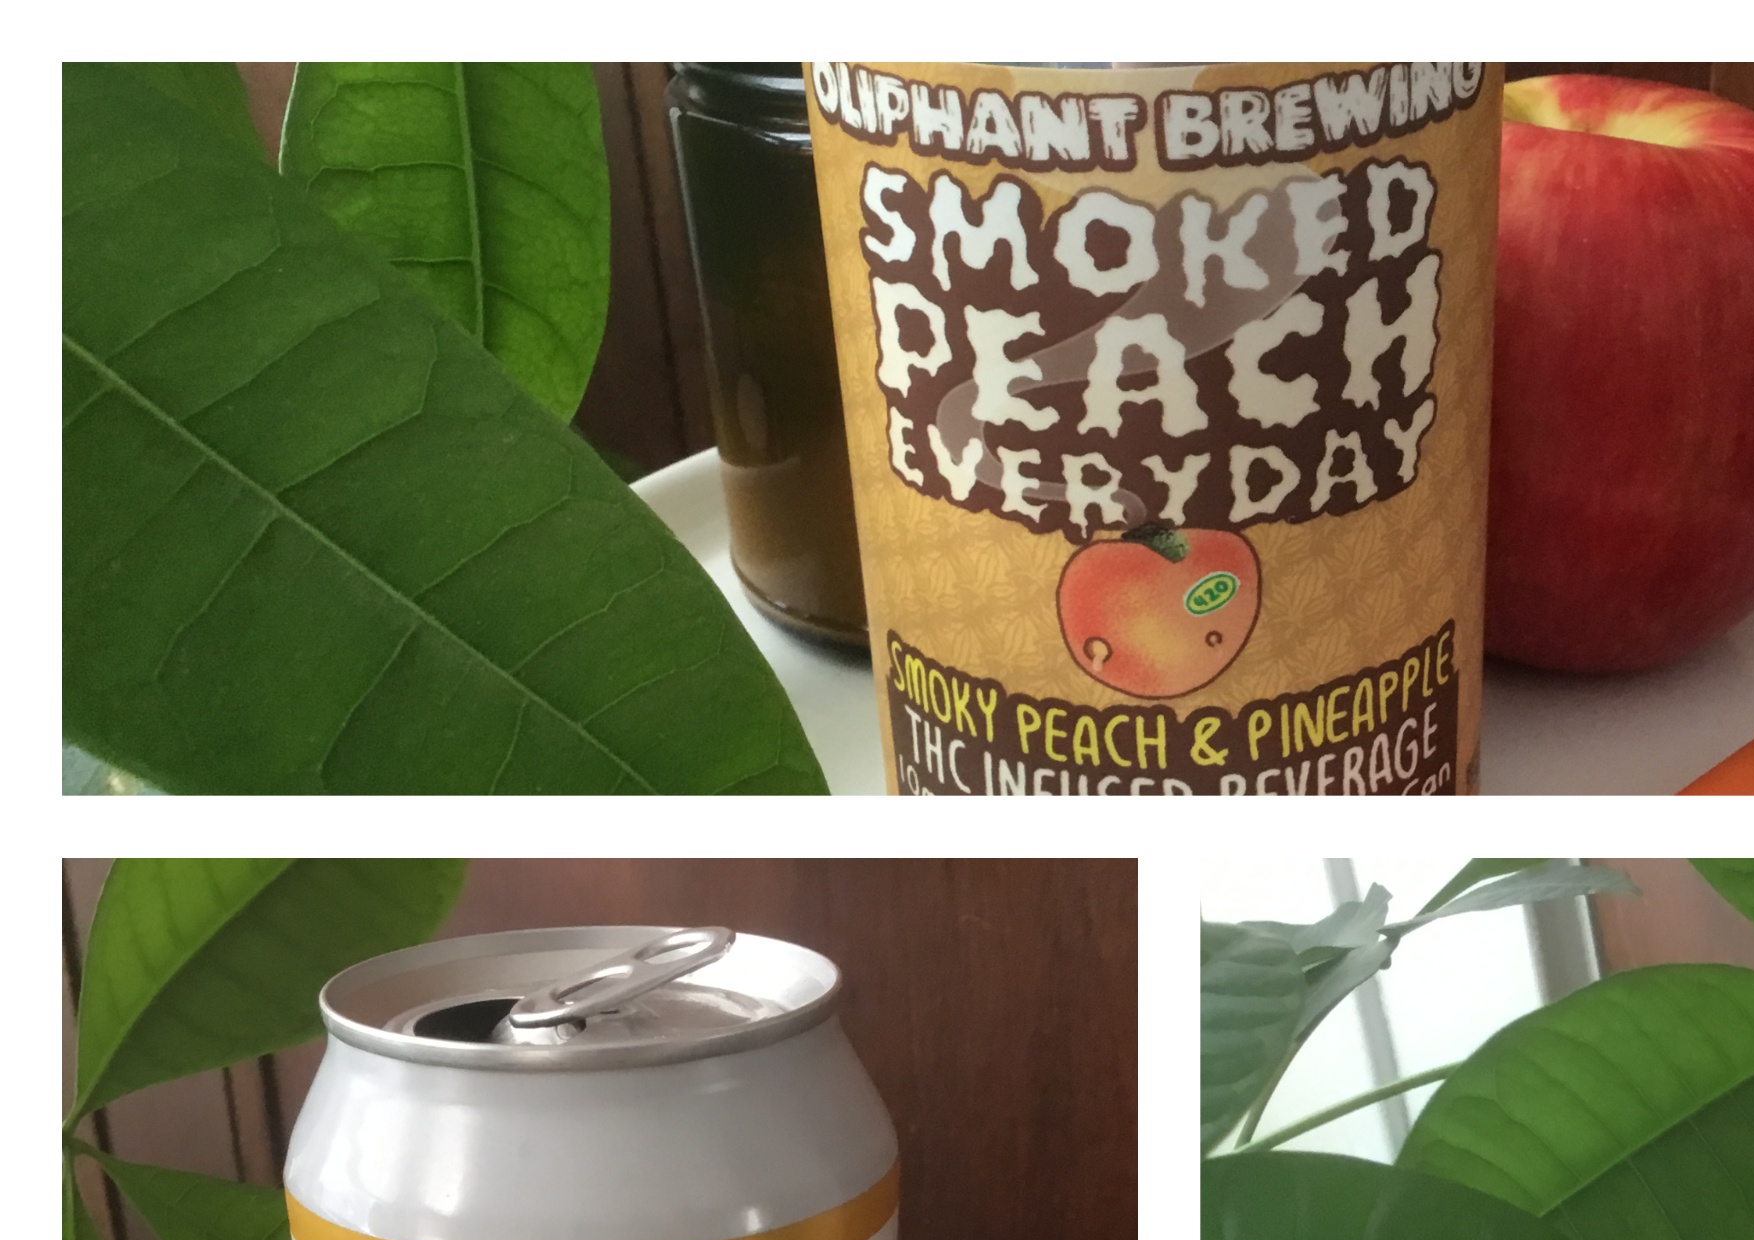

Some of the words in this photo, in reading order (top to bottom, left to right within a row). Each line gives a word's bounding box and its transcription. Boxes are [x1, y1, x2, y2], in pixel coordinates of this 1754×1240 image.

[812, 62, 1139, 161] OLIPHANT
[863, 160, 1434, 308] SMOKED
[874, 255, 1440, 437] PEACH
[890, 399, 1434, 538] EVERYDAY
[892, 639, 997, 742] SMOKY
[1017, 703, 1168, 769] PEACH
[1190, 715, 1229, 766] &
[1247, 629, 1449, 761] PINEAPPLE
[904, 704, 971, 795] THC
